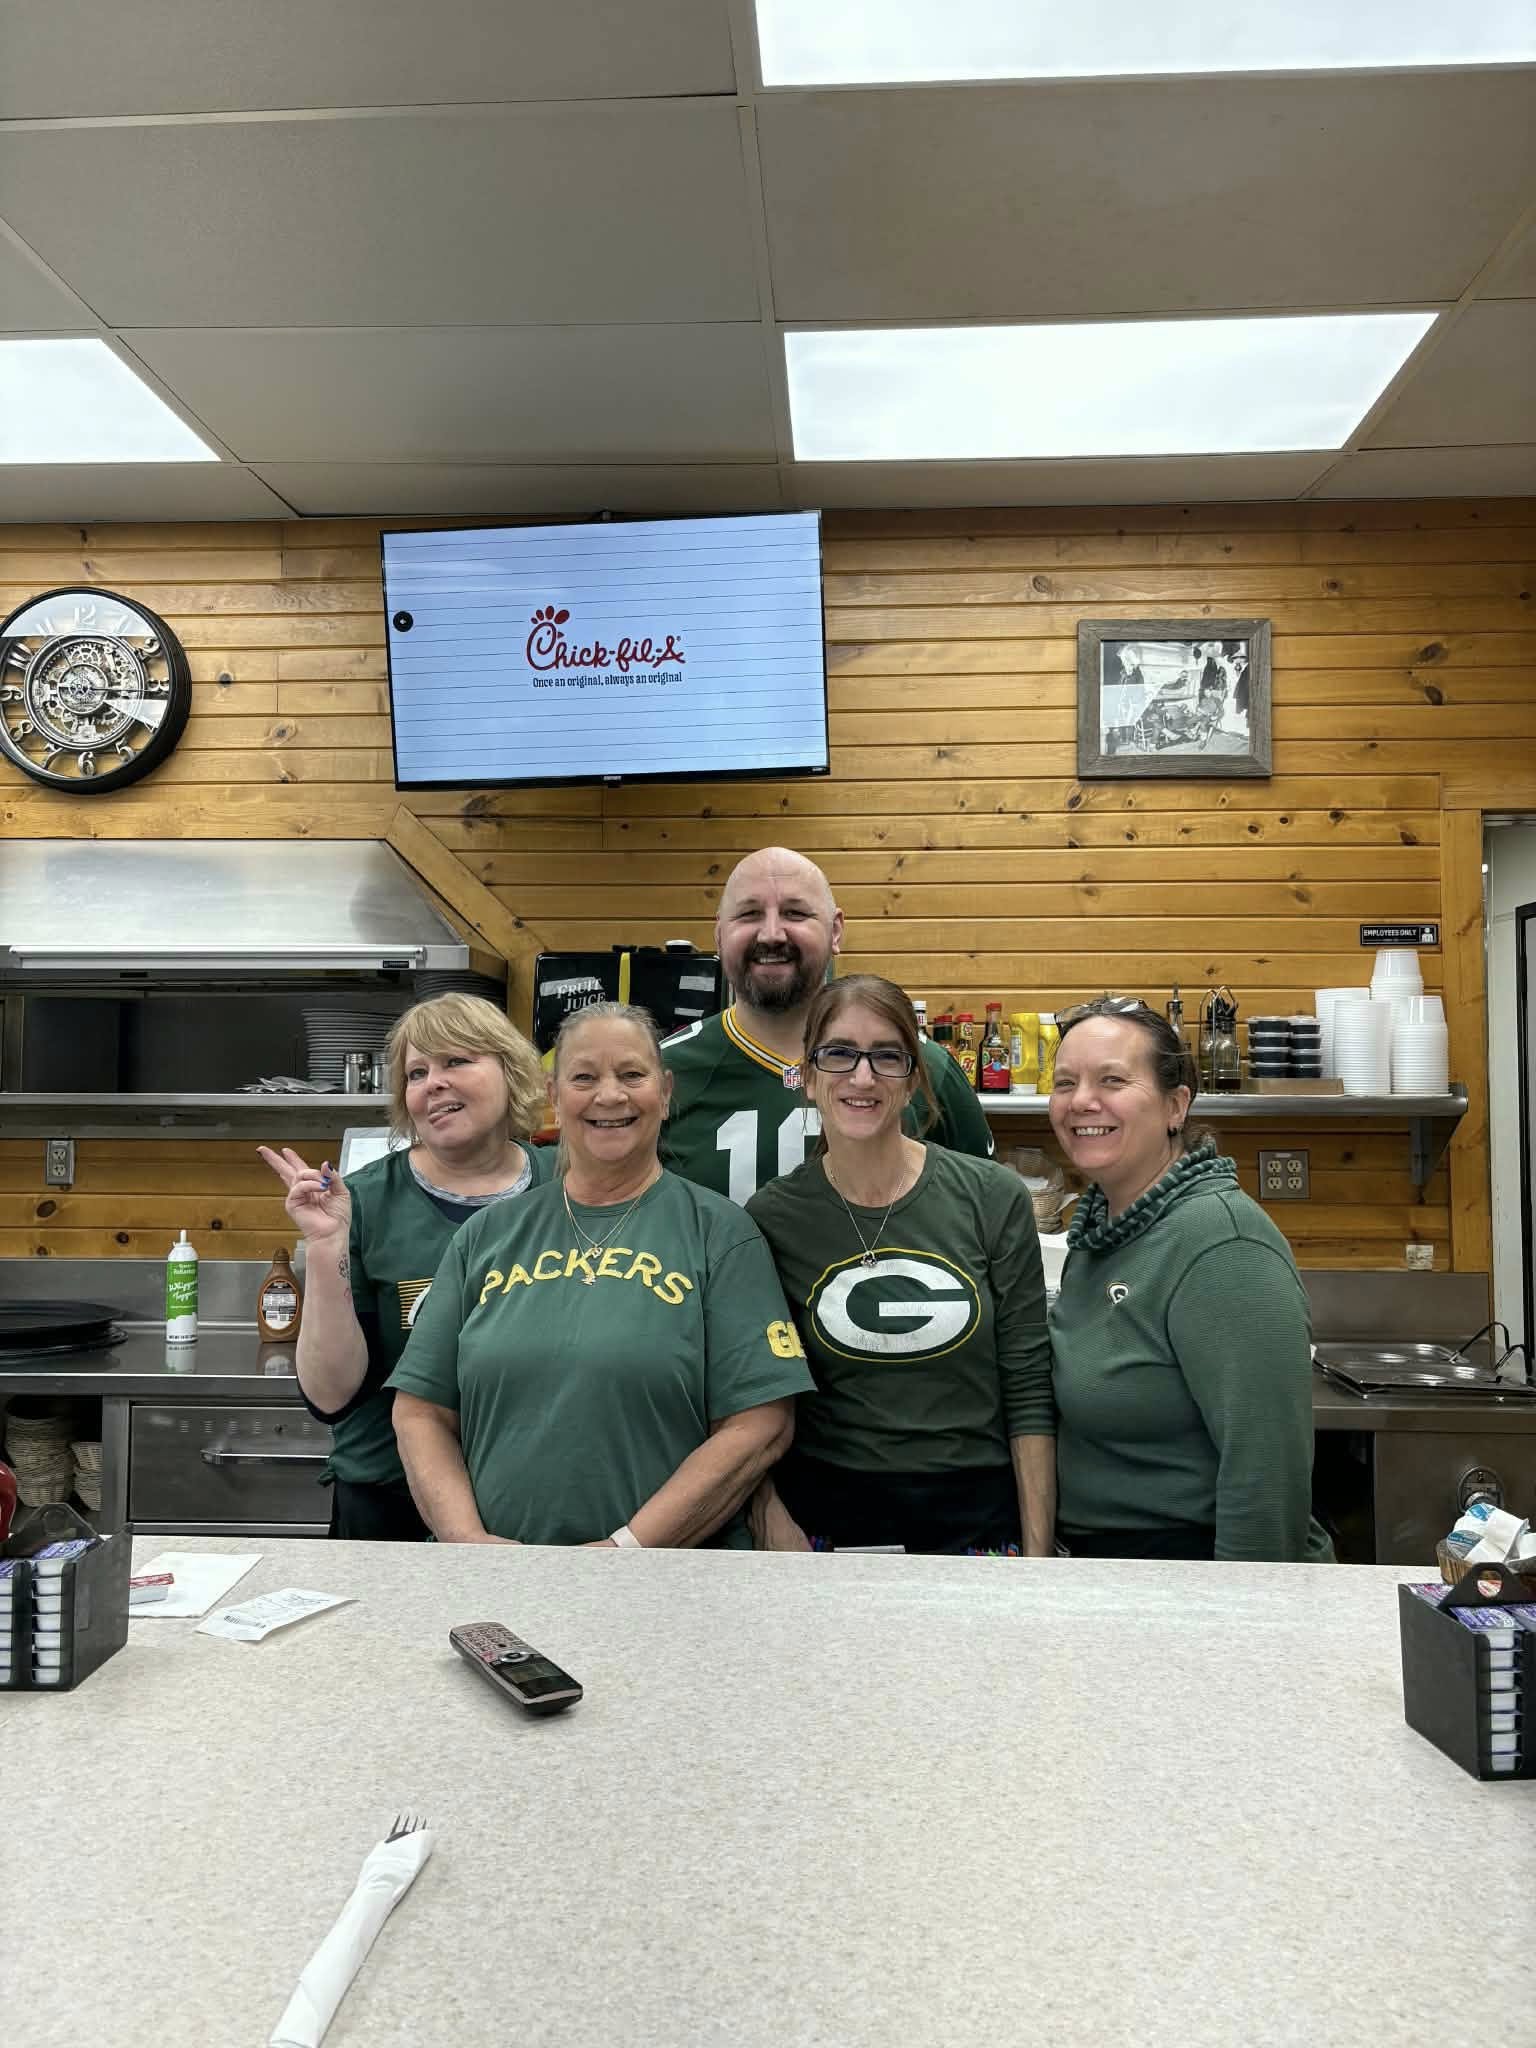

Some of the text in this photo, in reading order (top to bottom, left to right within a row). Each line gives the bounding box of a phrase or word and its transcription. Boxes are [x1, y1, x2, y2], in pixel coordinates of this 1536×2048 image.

[73, 602, 97, 627] 12
[526, 621, 687, 673] Chick-fil-A
[532, 671, 683, 688] Once an original, always an original
[77, 750, 97, 778] 6
[1363, 928, 1417, 937] EMPLOYEES ONLY
[556, 979, 602, 999] FRUIT
[563, 991, 606, 1012] JUICE
[479, 1247, 695, 1306] PACKERS
[817, 1258, 971, 1354] G
